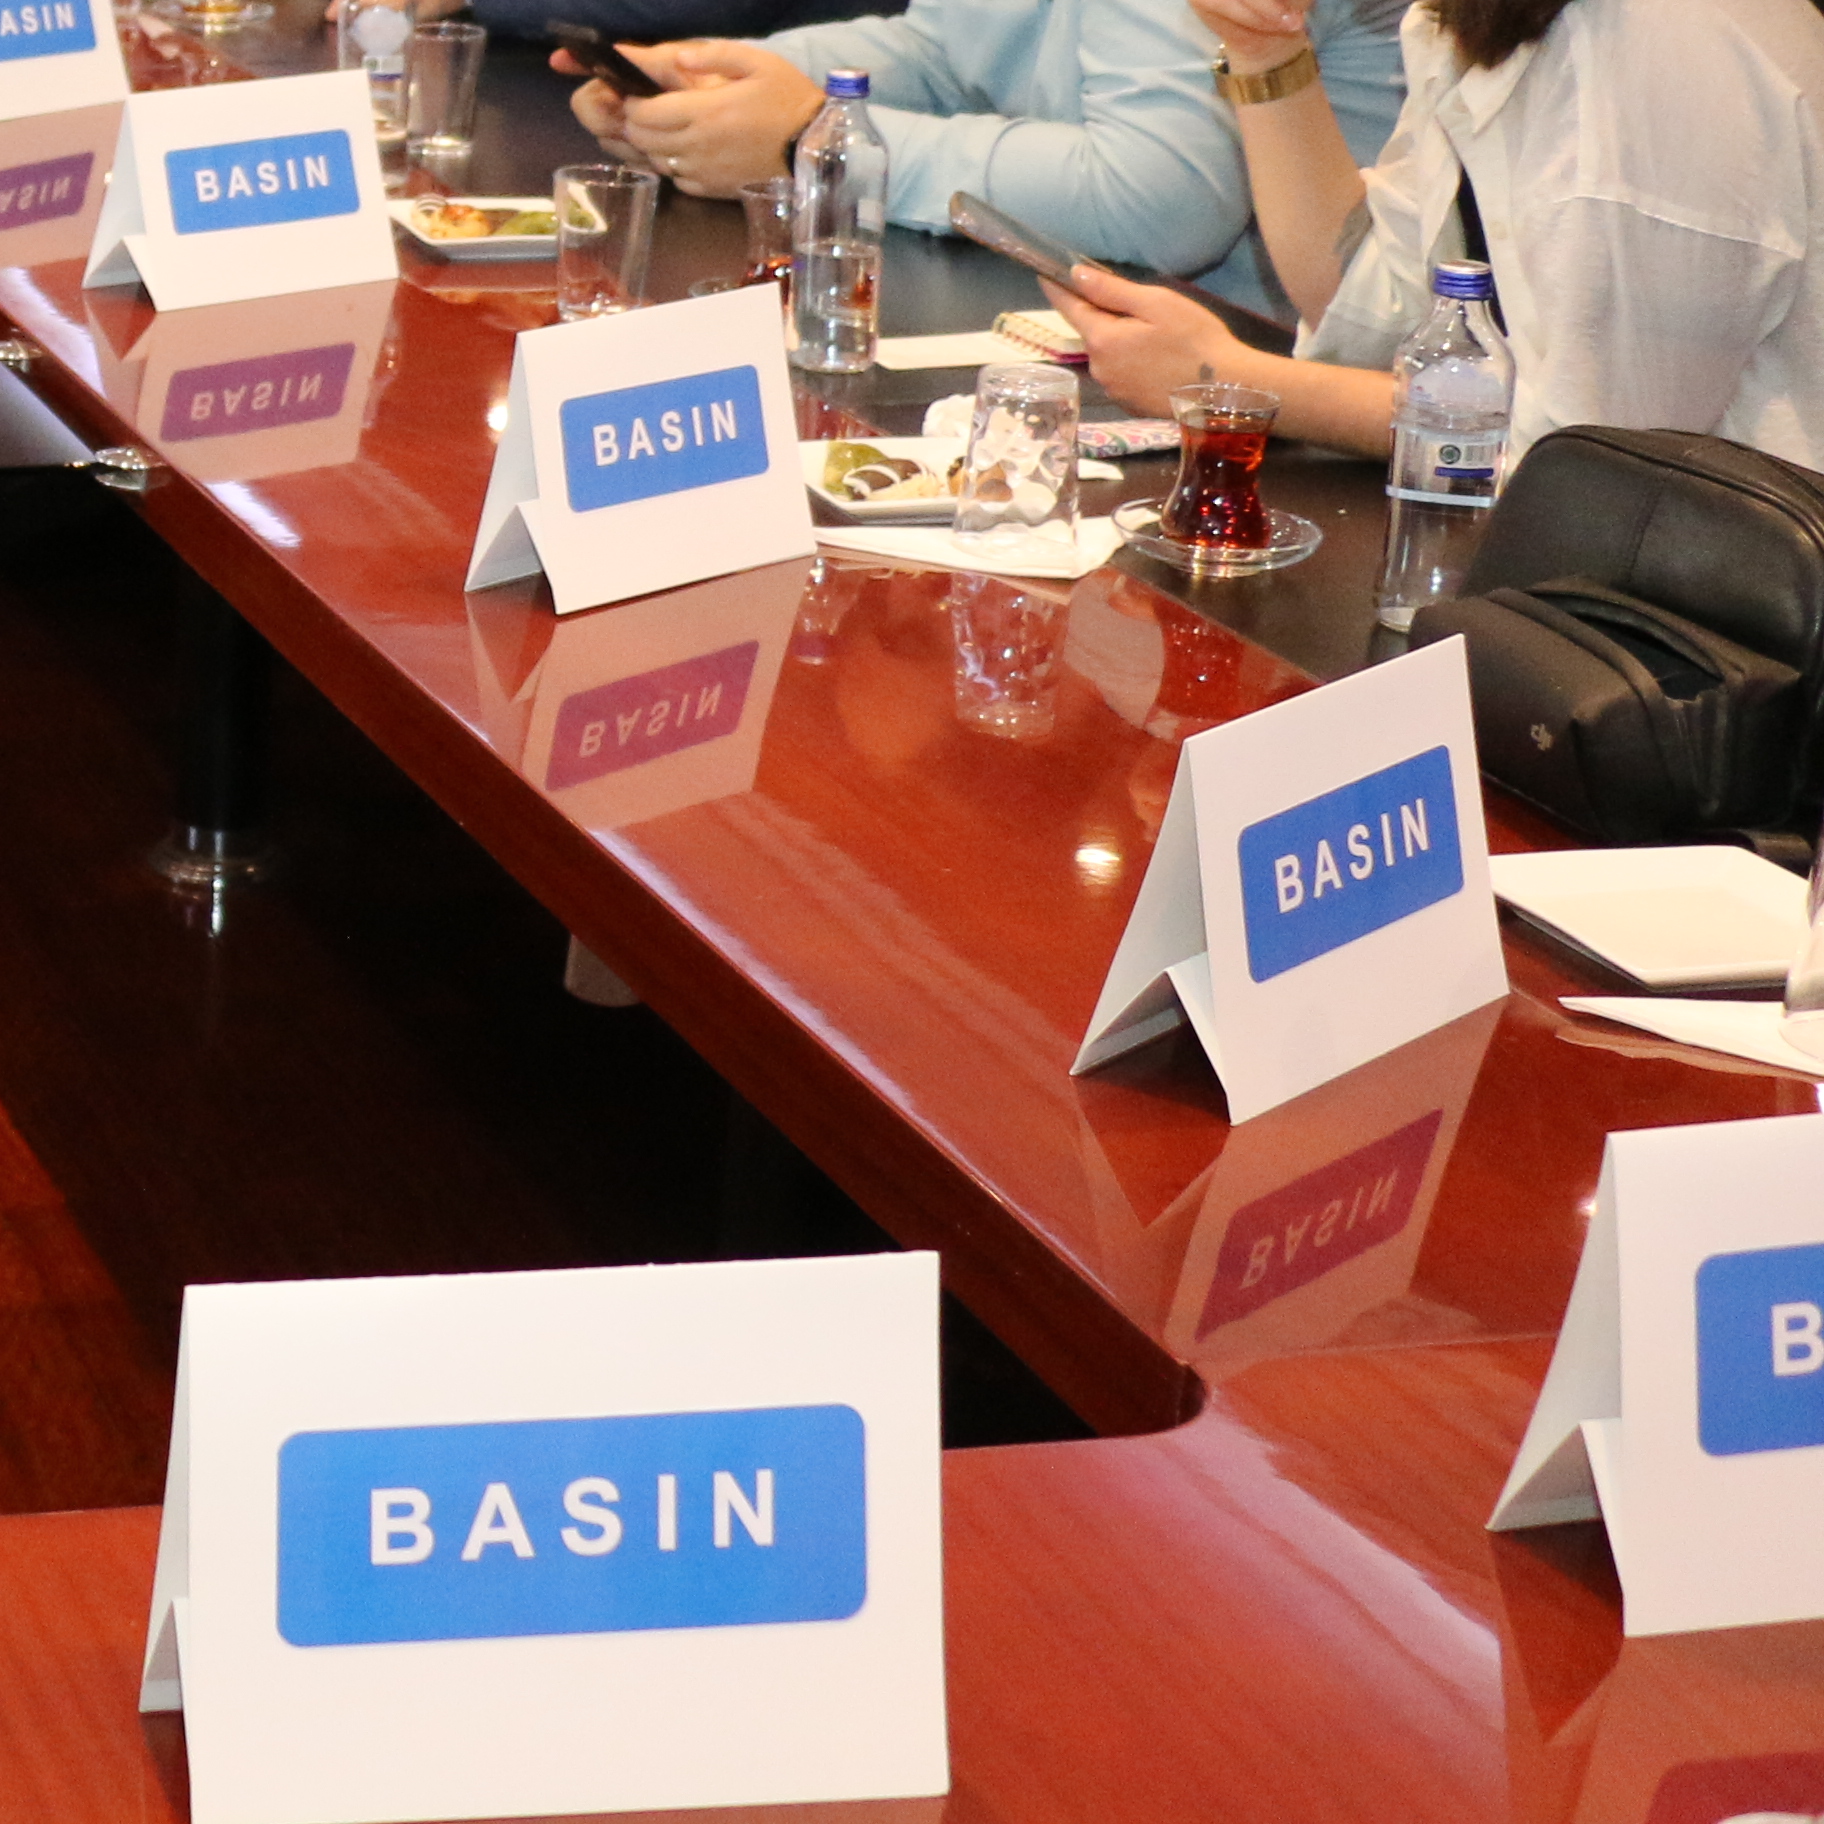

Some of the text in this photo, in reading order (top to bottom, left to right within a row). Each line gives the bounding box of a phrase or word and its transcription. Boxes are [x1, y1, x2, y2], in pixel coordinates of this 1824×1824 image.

[193, 154, 332, 204] BASIN
[591, 398, 740, 468] BASIN
[1273, 797, 1432, 915] BASIN
[369, 1468, 777, 1567] BASIN
